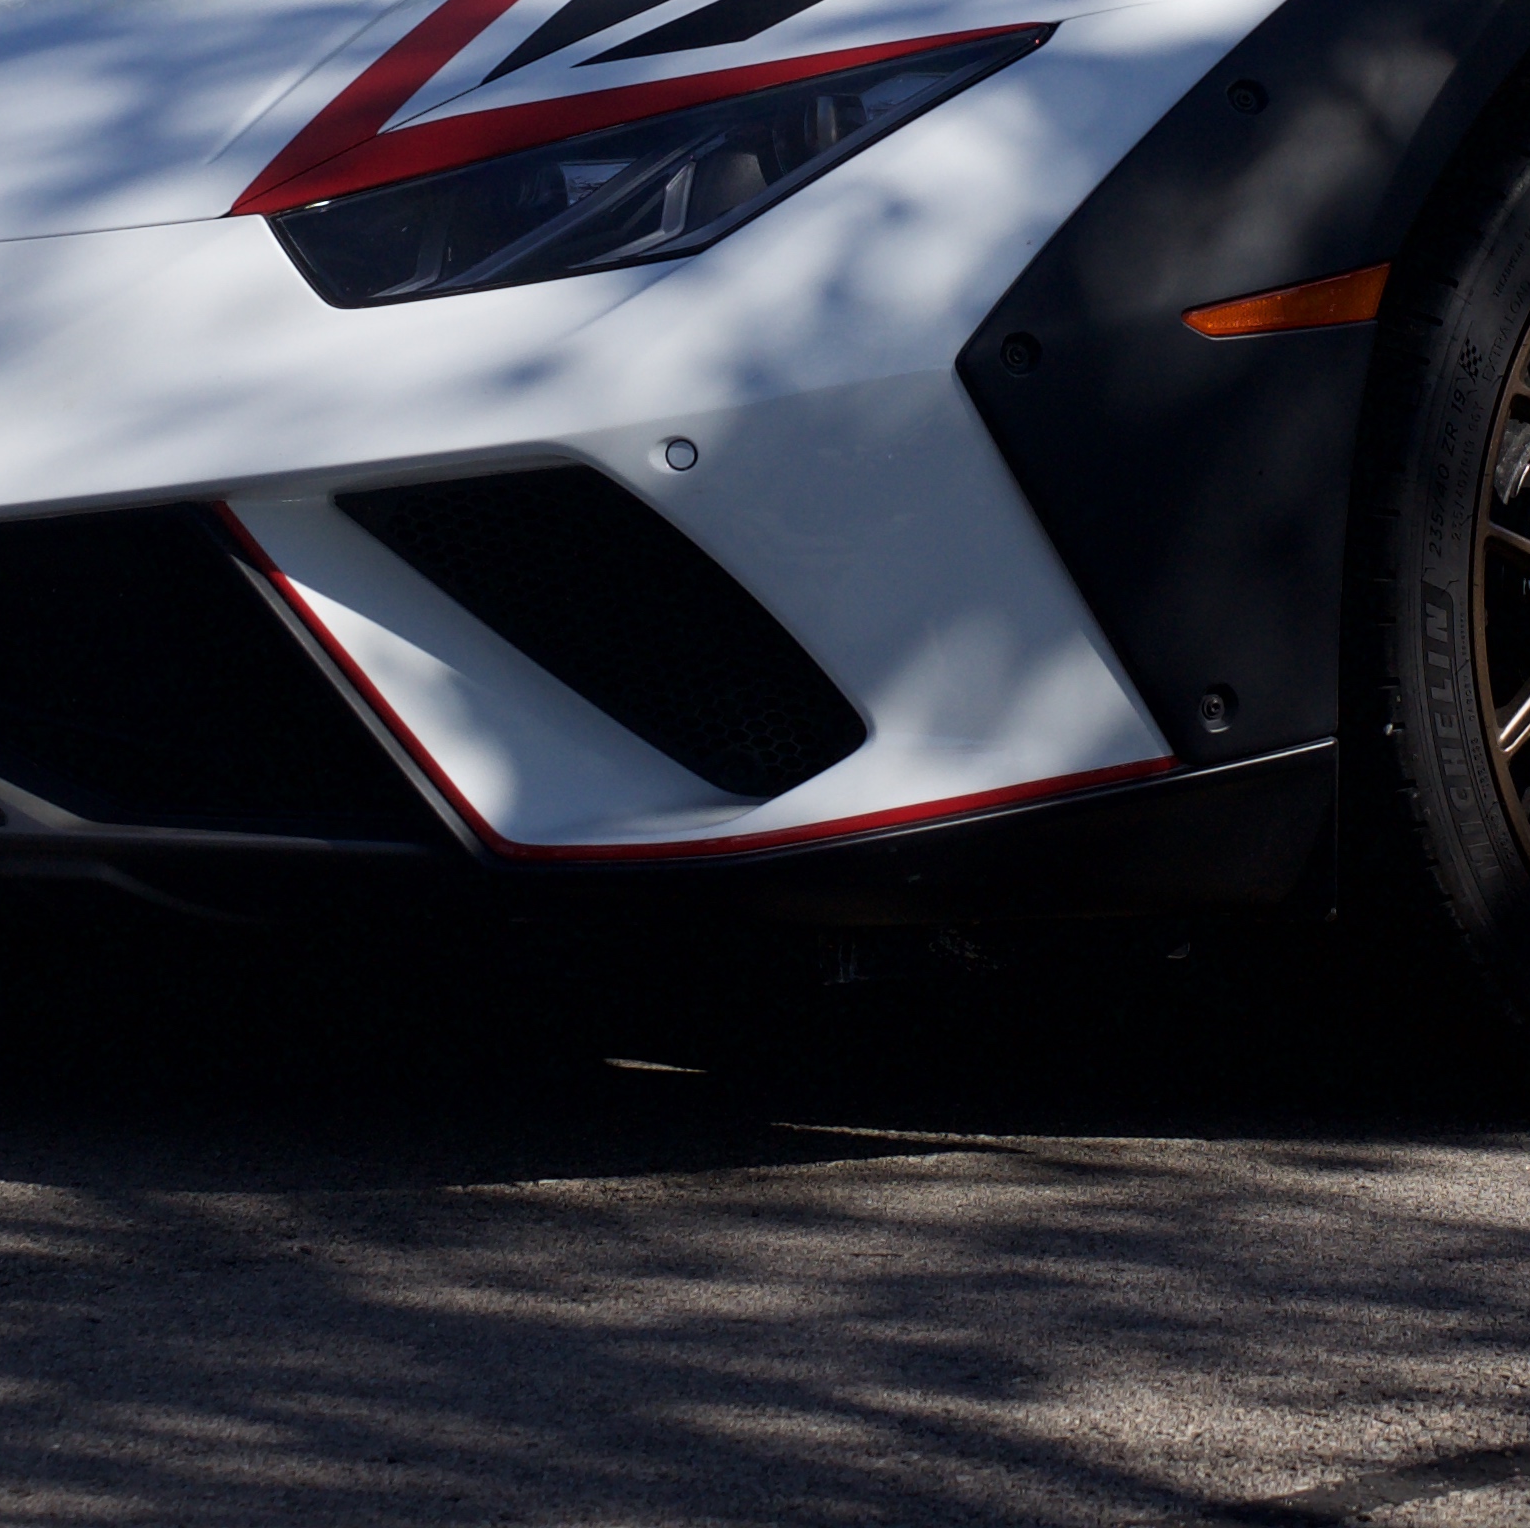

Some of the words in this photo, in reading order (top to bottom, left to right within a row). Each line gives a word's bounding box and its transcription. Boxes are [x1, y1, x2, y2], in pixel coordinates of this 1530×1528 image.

[1428, 462, 1450, 558] 235/40
[1440, 420, 1460, 457] ZR
[1450, 387, 1467, 414] 19
[1425, 601, 1502, 877] MICHELIN
